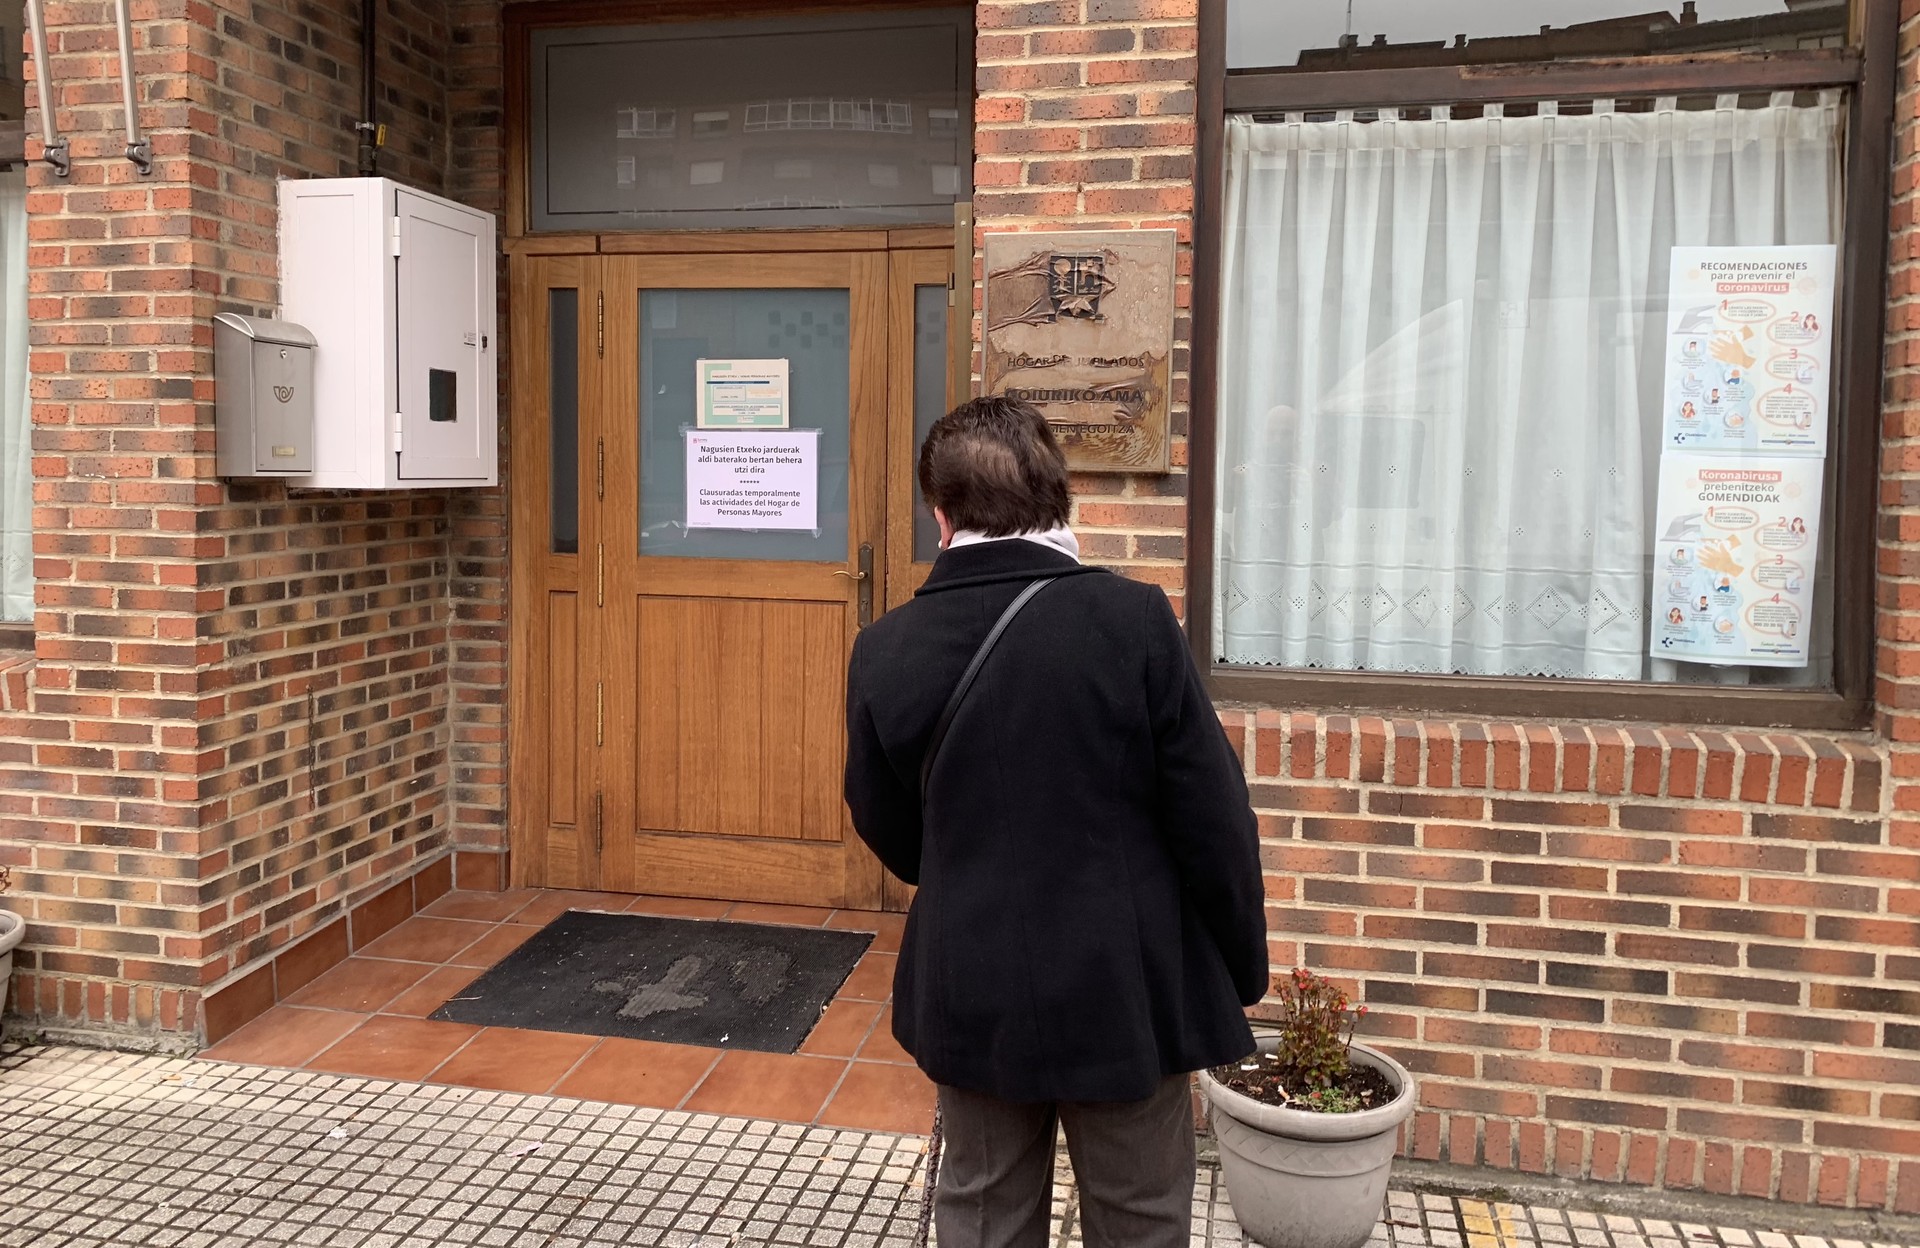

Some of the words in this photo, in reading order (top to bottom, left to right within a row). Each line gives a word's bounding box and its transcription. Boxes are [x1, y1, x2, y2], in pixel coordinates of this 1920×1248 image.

[1700, 262, 1808, 271] RECOMENDACIONES
[1710, 273, 1734, 281] para
[1737, 271, 1782, 281] prevenir
[1786, 271, 1796, 280] el
[1718, 283, 1787, 293] coronavirus
[1721, 299, 1728, 311] 1
[1790, 311, 1799, 323] 2
[1789, 348, 1798, 360] 3
[1007, 356, 1050, 367] HOGAR
[1782, 383, 1793, 395] 4
[1100, 389, 1143, 401] AMA
[1080, 424, 1135, 433] EGOITZA
[700, 445, 735, 454] Nagusien
[736, 445, 762, 454] Etxeko
[763, 445, 800, 454] jarduerak
[698, 455, 712, 463] aldi
[713, 455, 747, 463] baterako
[749, 456, 774, 464] bertan
[775, 456, 802, 464] behera
[750, 466, 765, 474] dira
[1701, 470, 1778, 481] Koronabirusa
[1704, 482, 1775, 492] prebenitzeko
[699, 488, 743, 496] Clausuradas
[744, 489, 801, 498] temporalmente
[1698, 492, 1780, 503] GOMENDIOAK
[699, 498, 711, 506] las
[712, 498, 753, 506] actividades
[754, 499, 766, 507] del
[767, 499, 789, 508] Hogar
[790, 499, 801, 507] de
[717, 508, 750, 516] Personas
[751, 509, 783, 517] Mayores
[1707, 505, 1715, 517] 1
[1778, 516, 1787, 528] 2
[1775, 554, 1784, 566] 3
[1770, 593, 1780, 604] 4
